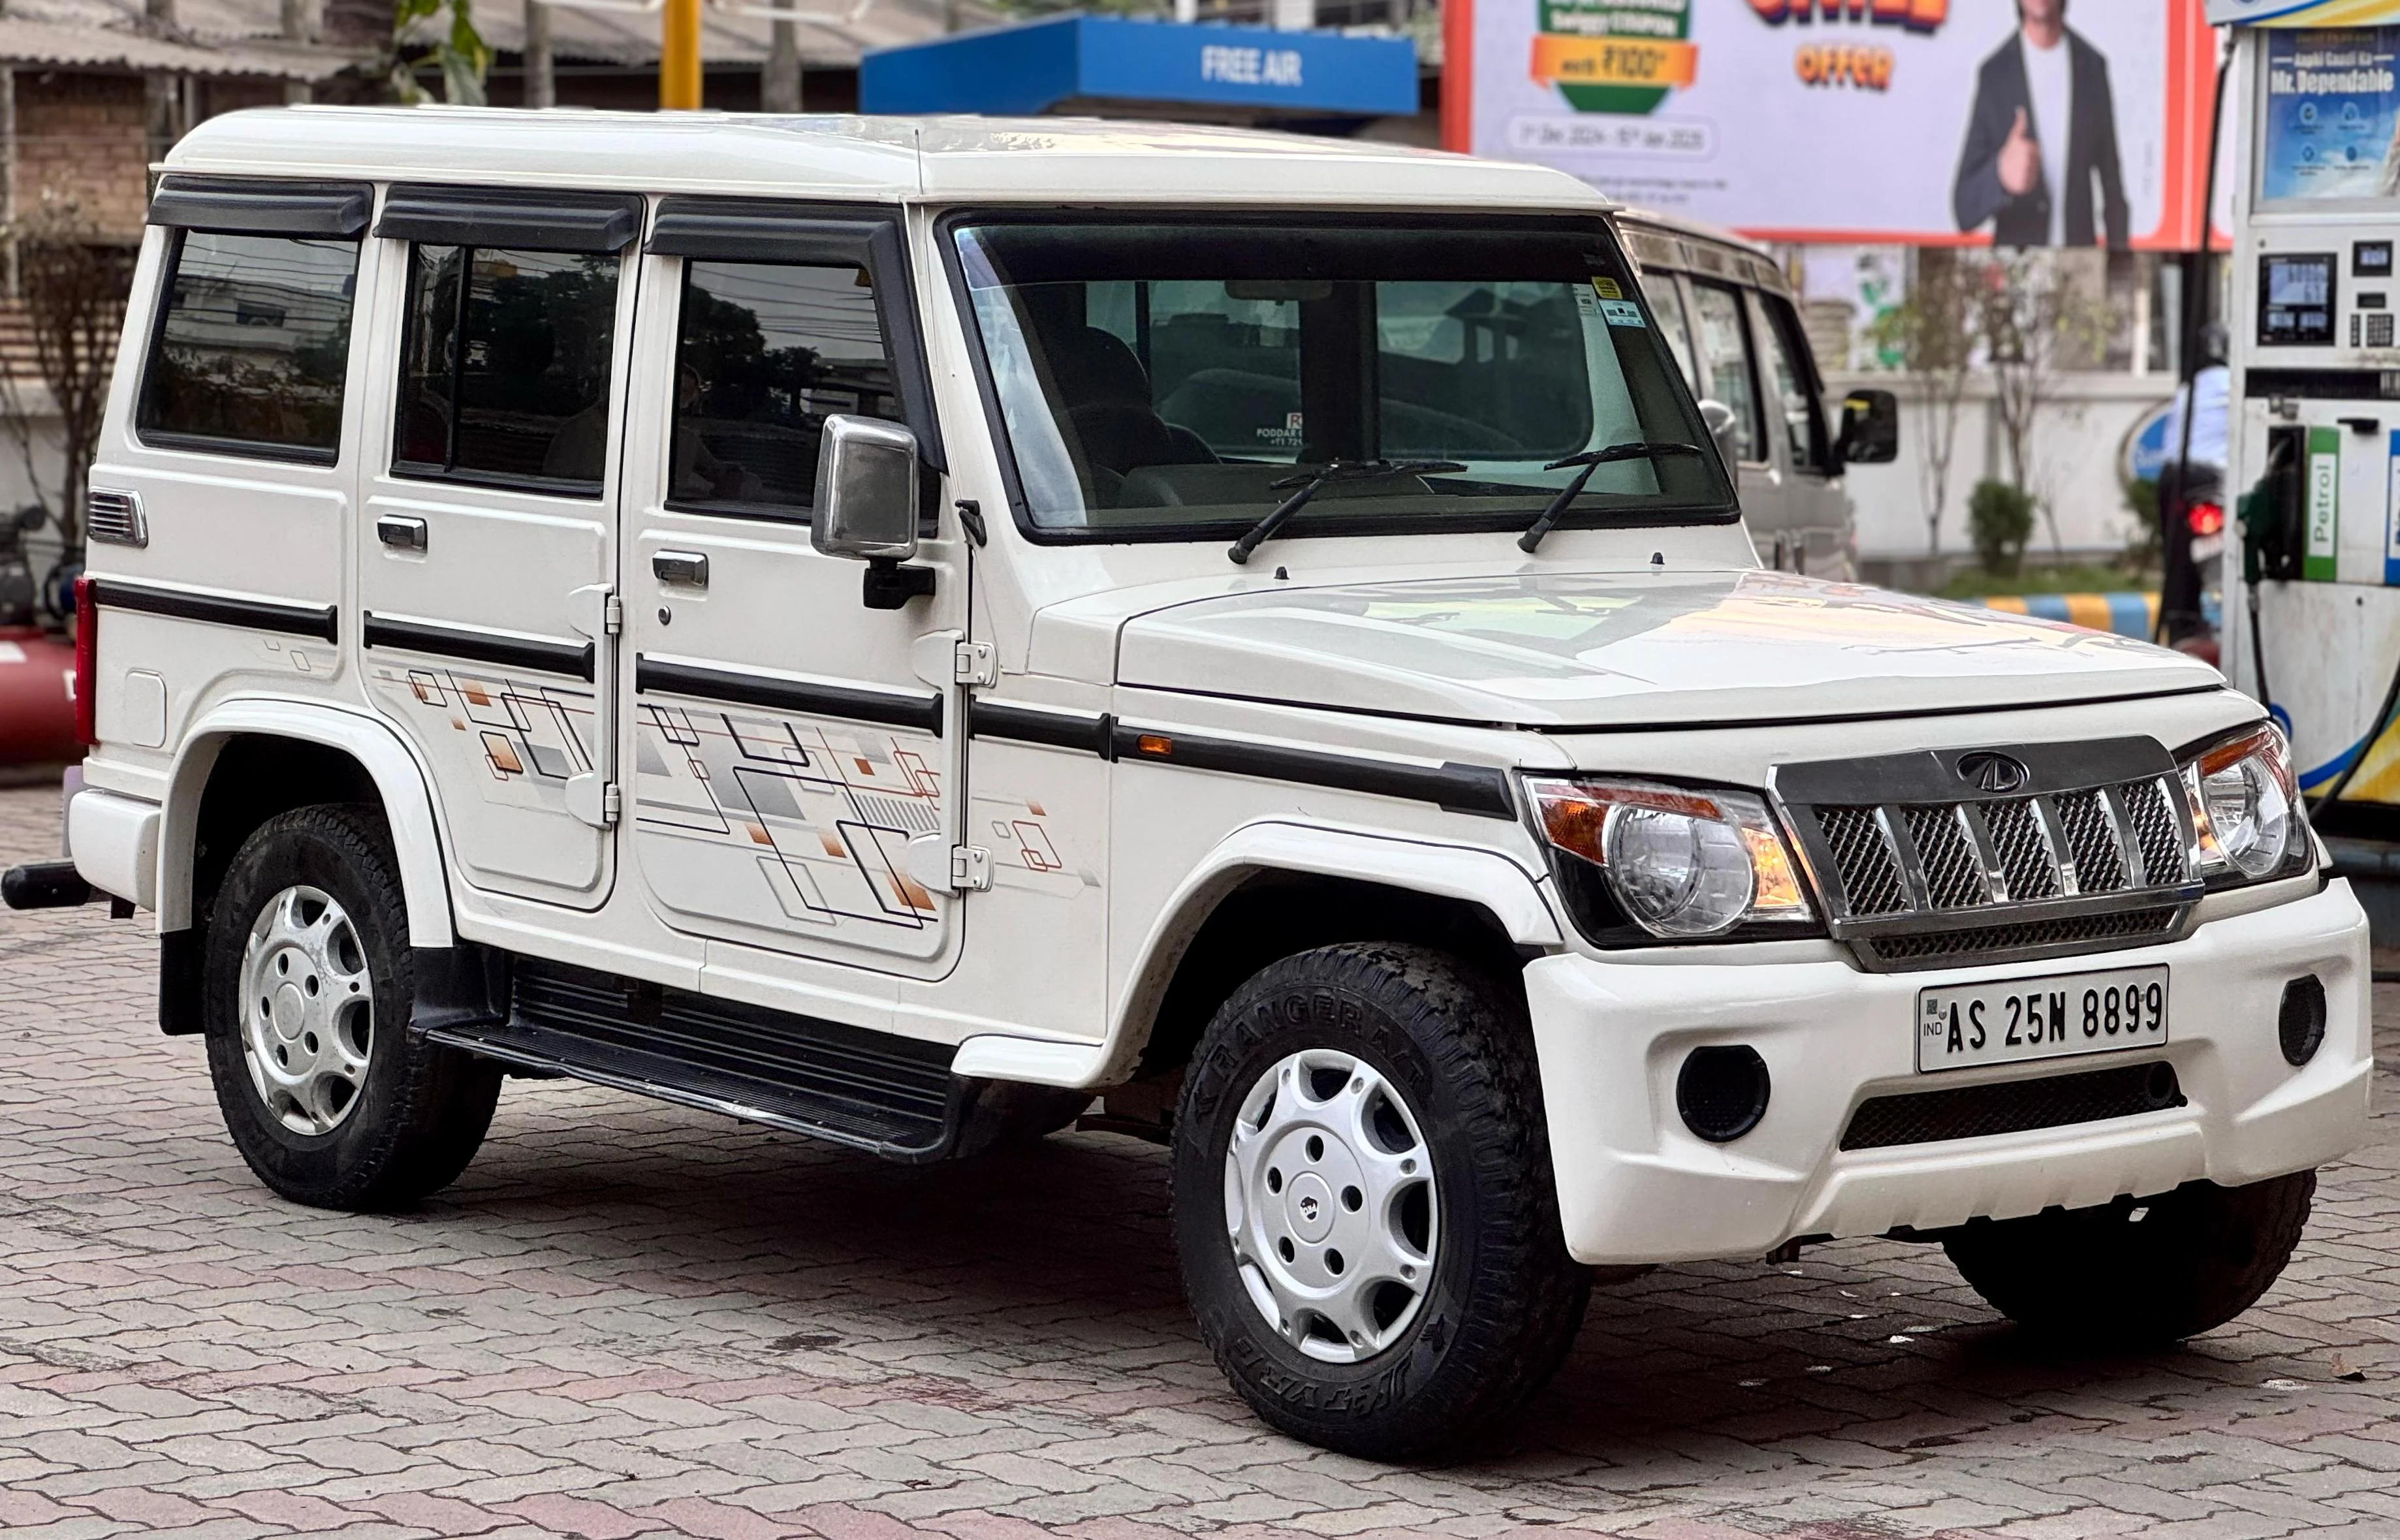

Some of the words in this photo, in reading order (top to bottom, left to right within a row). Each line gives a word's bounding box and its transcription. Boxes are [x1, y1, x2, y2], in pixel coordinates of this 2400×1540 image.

[1201, 45, 1261, 85] FREE
[1263, 48, 1303, 87] AIR
[1797, 44, 1891, 92] OFFER
[2271, 69, 2296, 94] Mr.
[2296, 67, 2395, 96] Dependable
[1257, 428, 1296, 437] PODDAR
[2314, 464, 2330, 542] Petrol
[1209, 992, 1365, 1082] RANGER
[1923, 1022, 1943, 1037] IND
[1947, 999, 1986, 1053] AS
[2004, 992, 2066, 1046] 25N
[2083, 982, 2162, 1038] 8899
